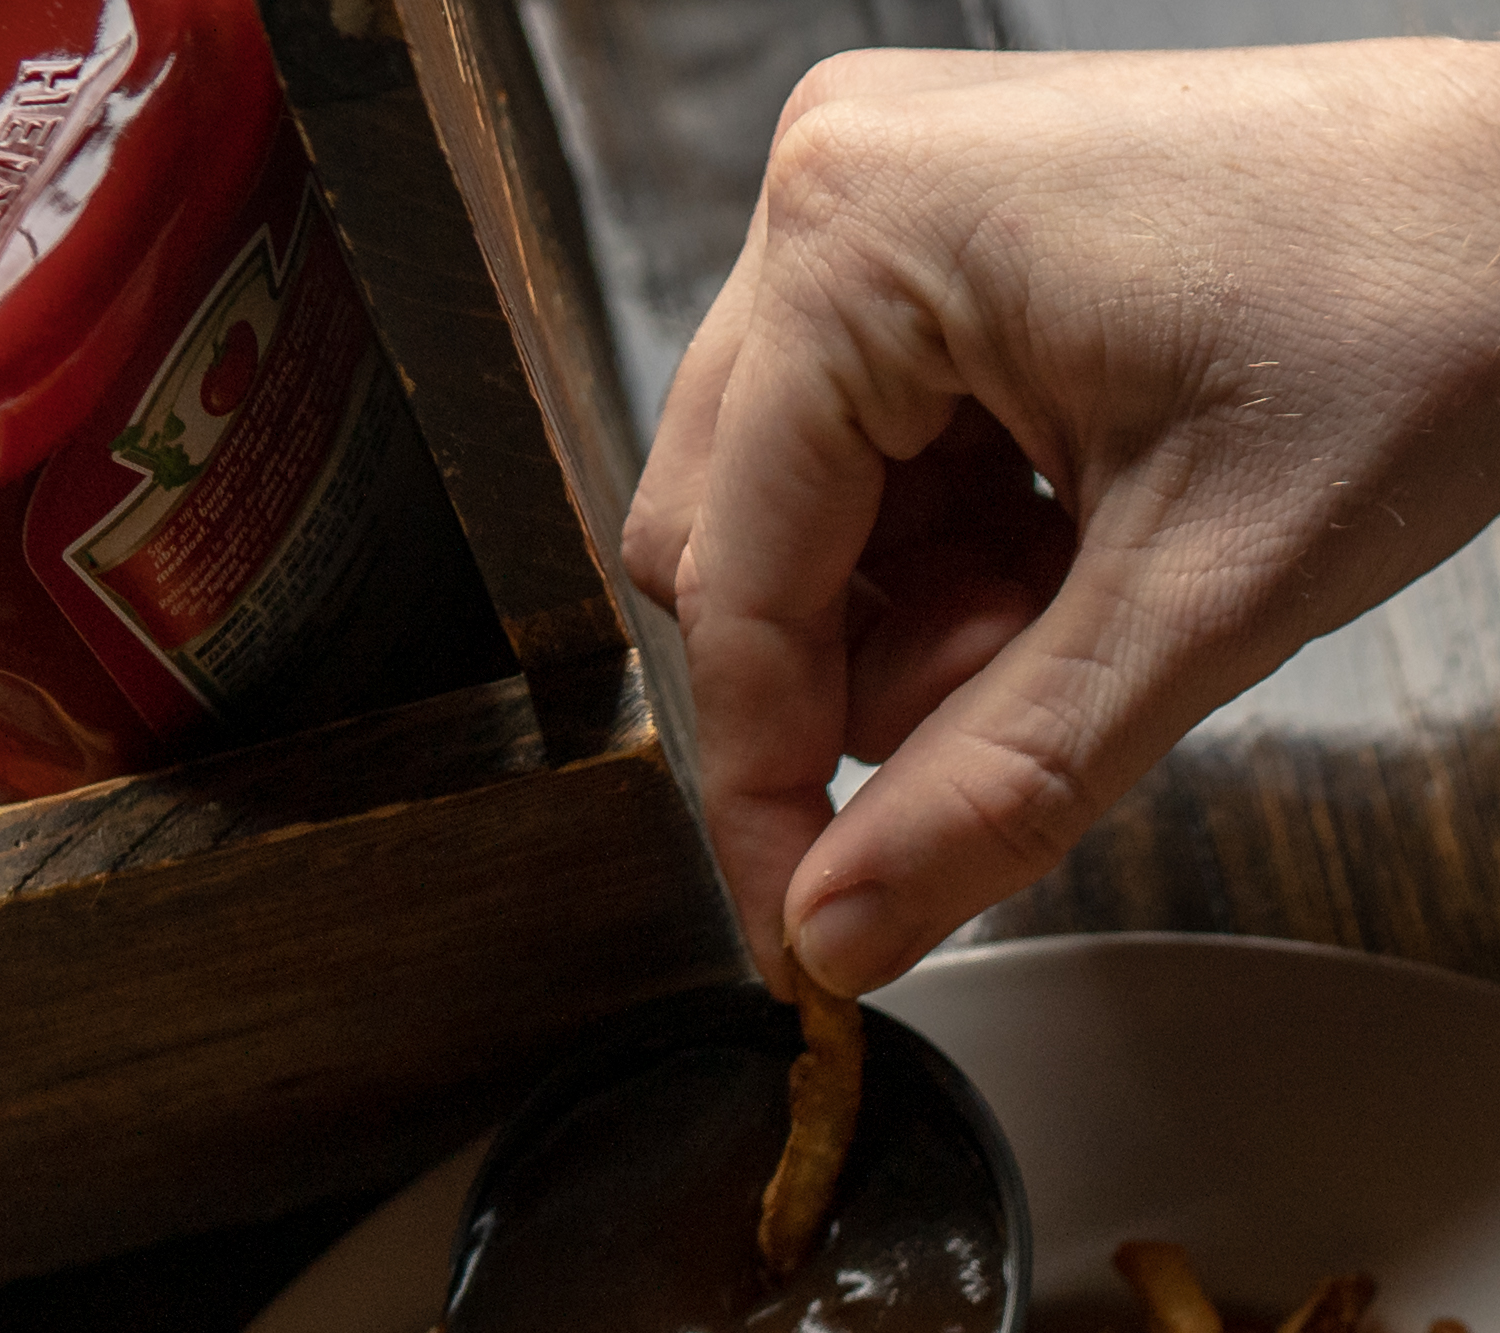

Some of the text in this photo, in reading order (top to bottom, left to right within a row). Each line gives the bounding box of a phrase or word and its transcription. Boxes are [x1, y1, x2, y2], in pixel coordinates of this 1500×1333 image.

[145, 524, 178, 558] Spice
[177, 505, 195, 524] up
[191, 473, 218, 507] your
[212, 417, 254, 474] chicken
[152, 542, 178, 570] ribs
[177, 516, 199, 544] and
[196, 461, 240, 518] burgers,
[154, 524, 211, 584] meatloaf,
[208, 490, 235, 522] fries
[188, 524, 250, 597] hamburgers
